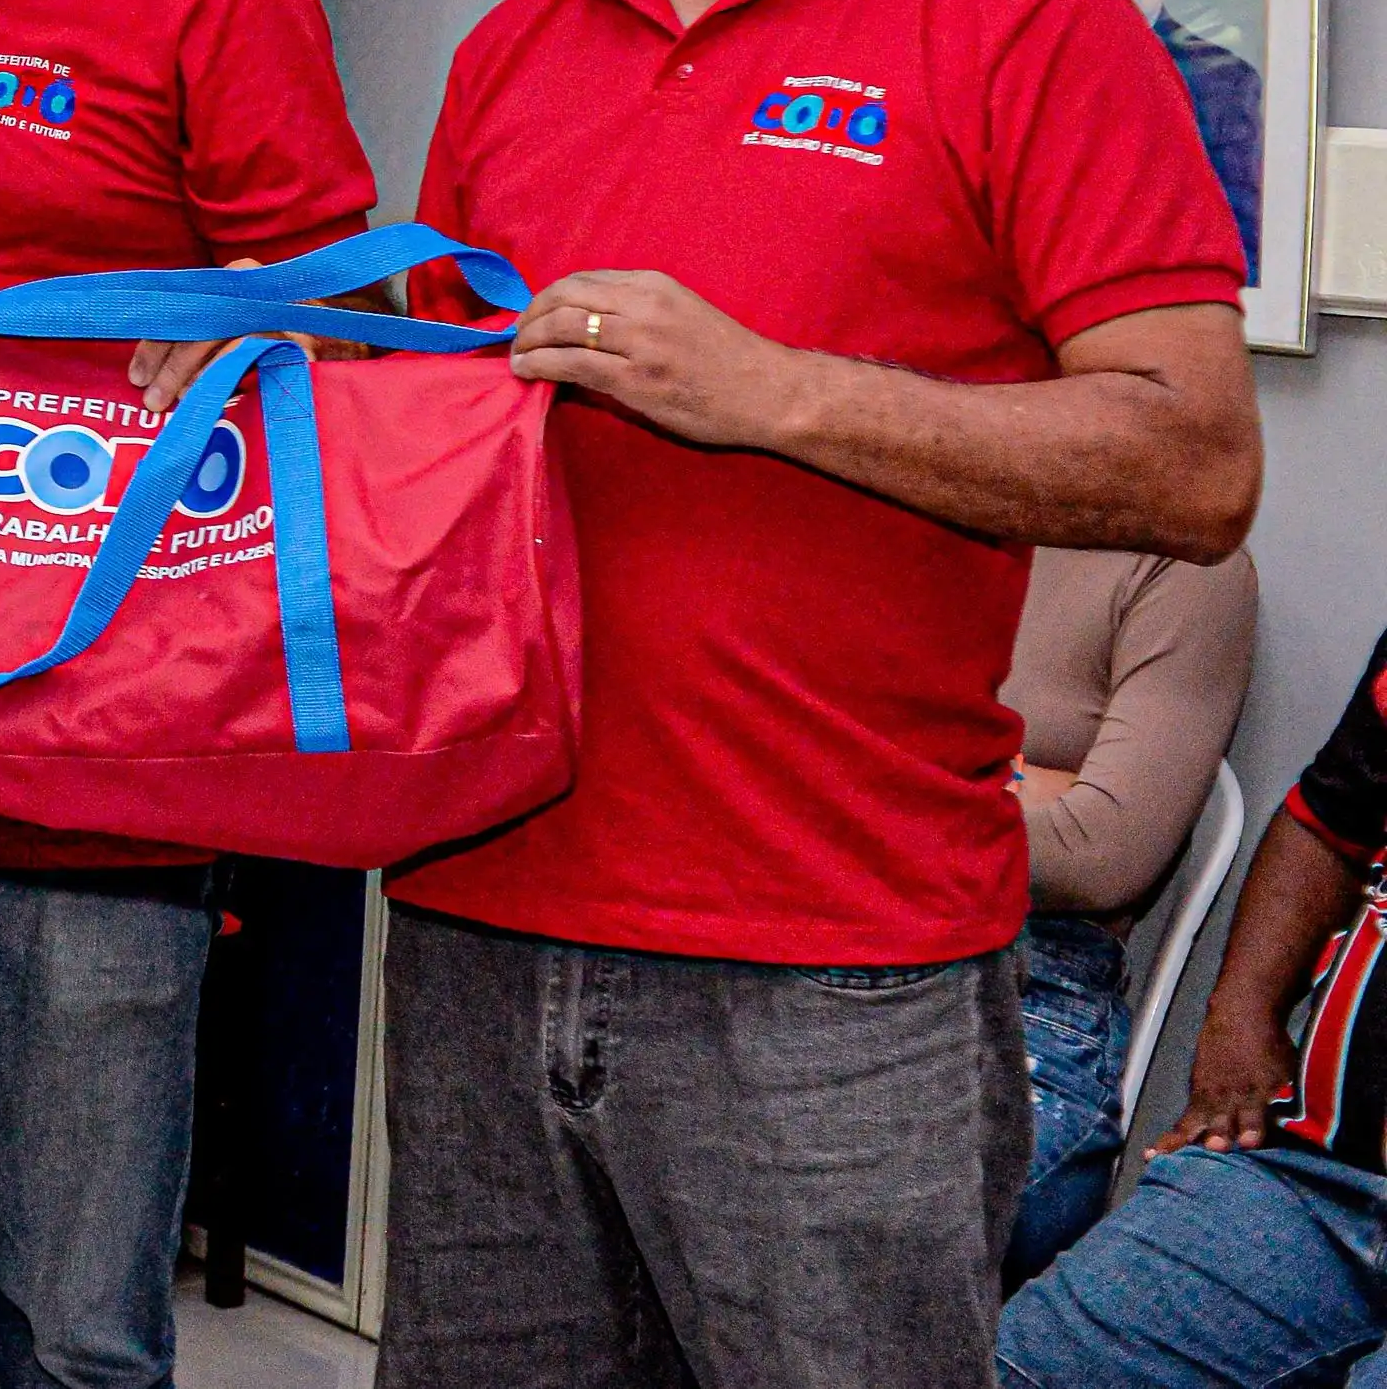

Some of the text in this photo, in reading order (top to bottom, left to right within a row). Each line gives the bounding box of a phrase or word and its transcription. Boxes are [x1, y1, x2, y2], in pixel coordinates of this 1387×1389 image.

[53, 63, 71, 77] DE
[18, 120, 27, 130] E
[29, 122, 71, 140] FUTURO
[821, 142, 833, 154] E
[170, 505, 274, 555] FUTURO
[10, 551, 98, 570] MUNICIPA
[135, 555, 209, 580] ESPORTE
[210, 553, 223, 568] E
[223, 542, 275, 564] LAZER
